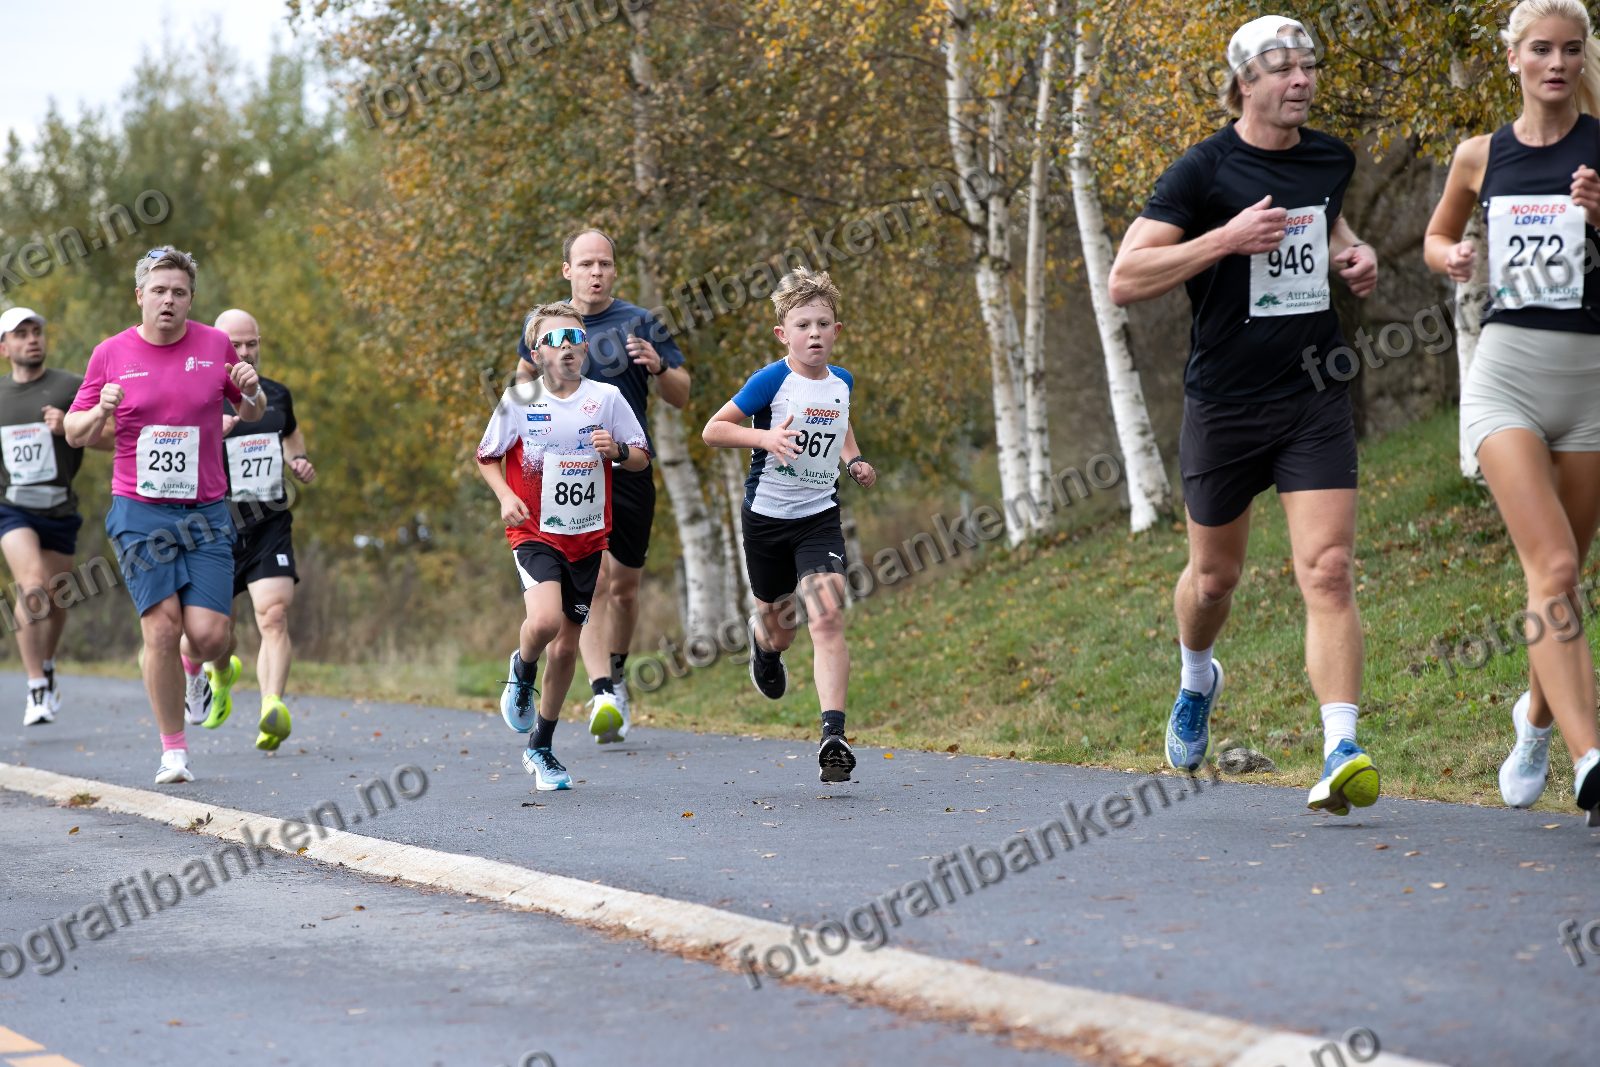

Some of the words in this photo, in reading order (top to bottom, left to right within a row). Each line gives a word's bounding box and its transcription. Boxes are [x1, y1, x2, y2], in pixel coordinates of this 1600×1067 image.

[1510, 204, 1567, 214] NORGES
[1514, 215, 1556, 225] LØPET
[1508, 234, 1564, 267] 272
[1268, 243, 1315, 278] 946
[1286, 288, 1328, 301] Aurskog
[804, 408, 840, 418] NORGES
[805, 417, 834, 425] LØPET
[152, 430, 189, 439] NORGES
[154, 438, 183, 446] LØPET
[793, 430, 836, 458] 967
[13, 444, 42, 463] 207
[148, 449, 187, 473] 233
[241, 456, 273, 478] 277
[558, 460, 598, 469] NORGES
[561, 468, 593, 476] LØPET
[802, 468, 835, 481] Aurskog
[554, 481, 596, 507] 864
[569, 513, 602, 525] Aurskog
